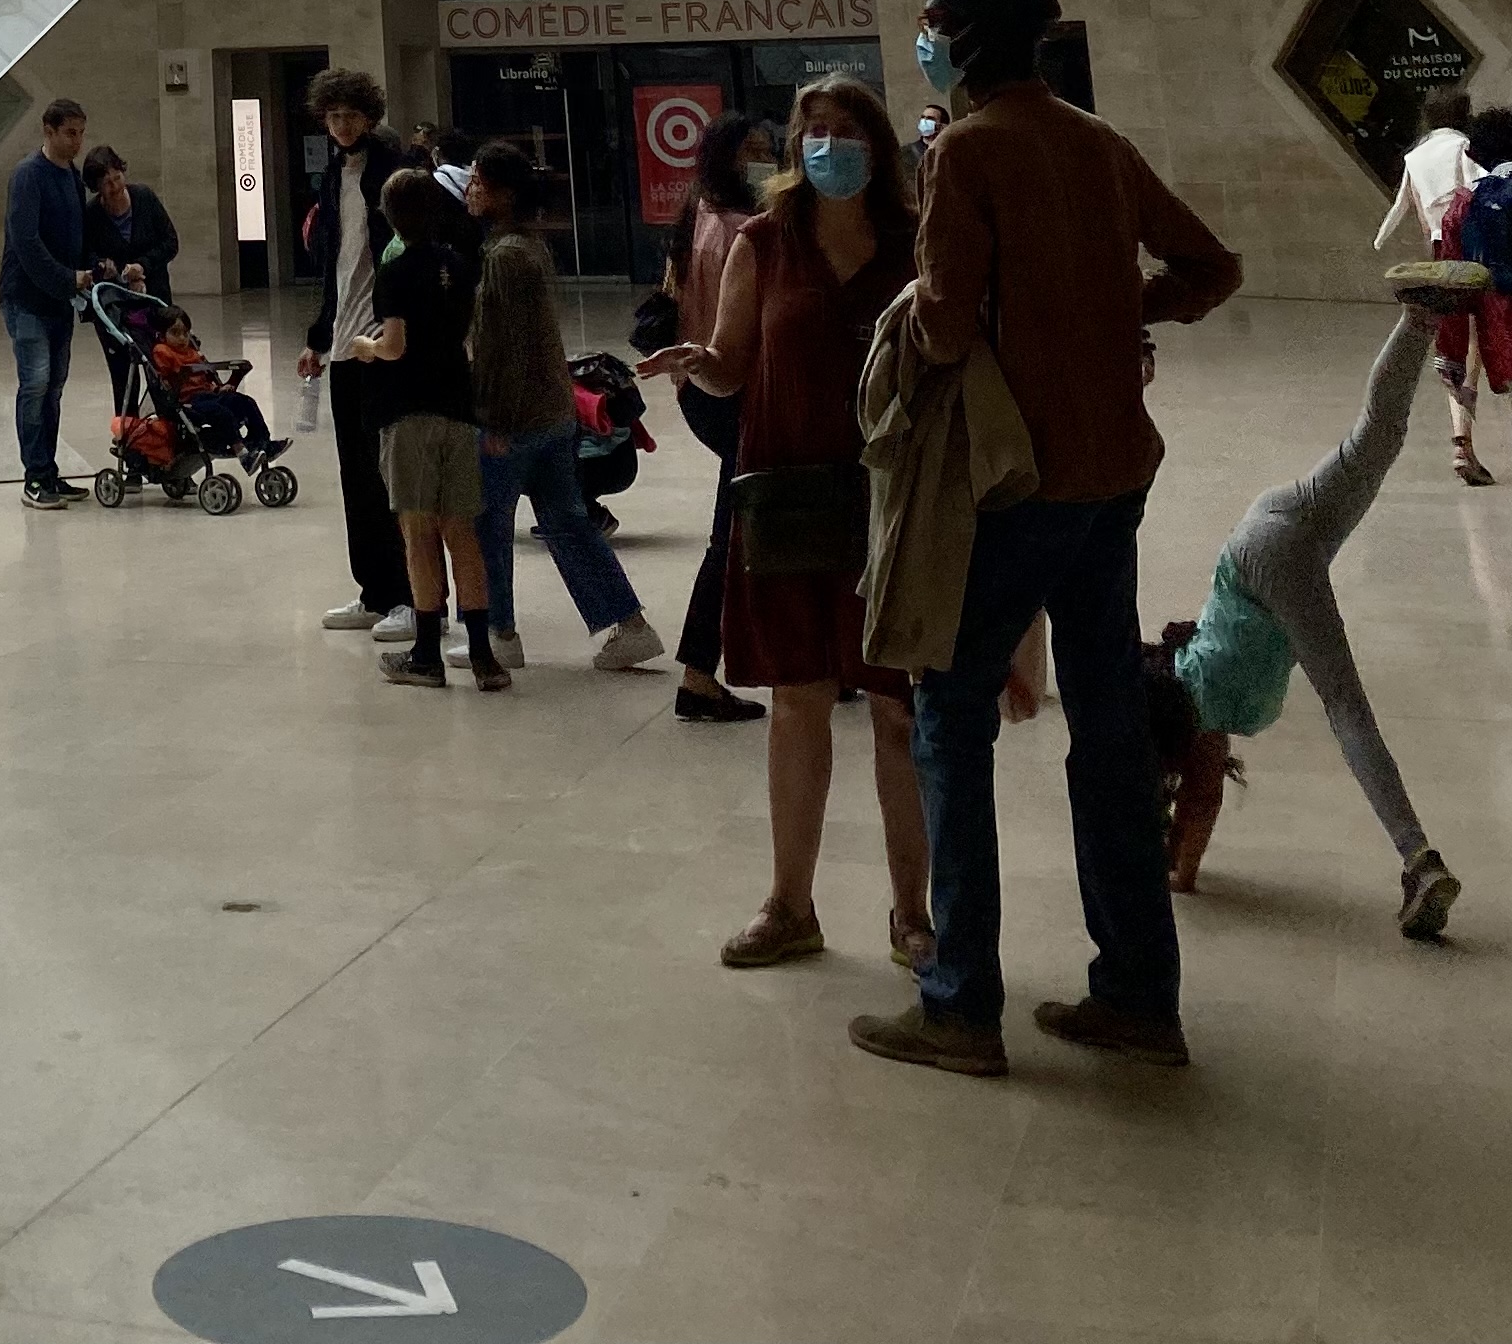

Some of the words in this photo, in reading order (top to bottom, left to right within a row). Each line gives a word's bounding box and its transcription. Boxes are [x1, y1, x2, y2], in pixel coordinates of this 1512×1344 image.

[1392, 56, 1408, 66] LA
[1411, 53, 1462, 65] MAISON
[499, 67, 549, 80] Librairie
[1384, 69, 1400, 79] DU
[1404, 66, 1466, 79] CHOCOLA
